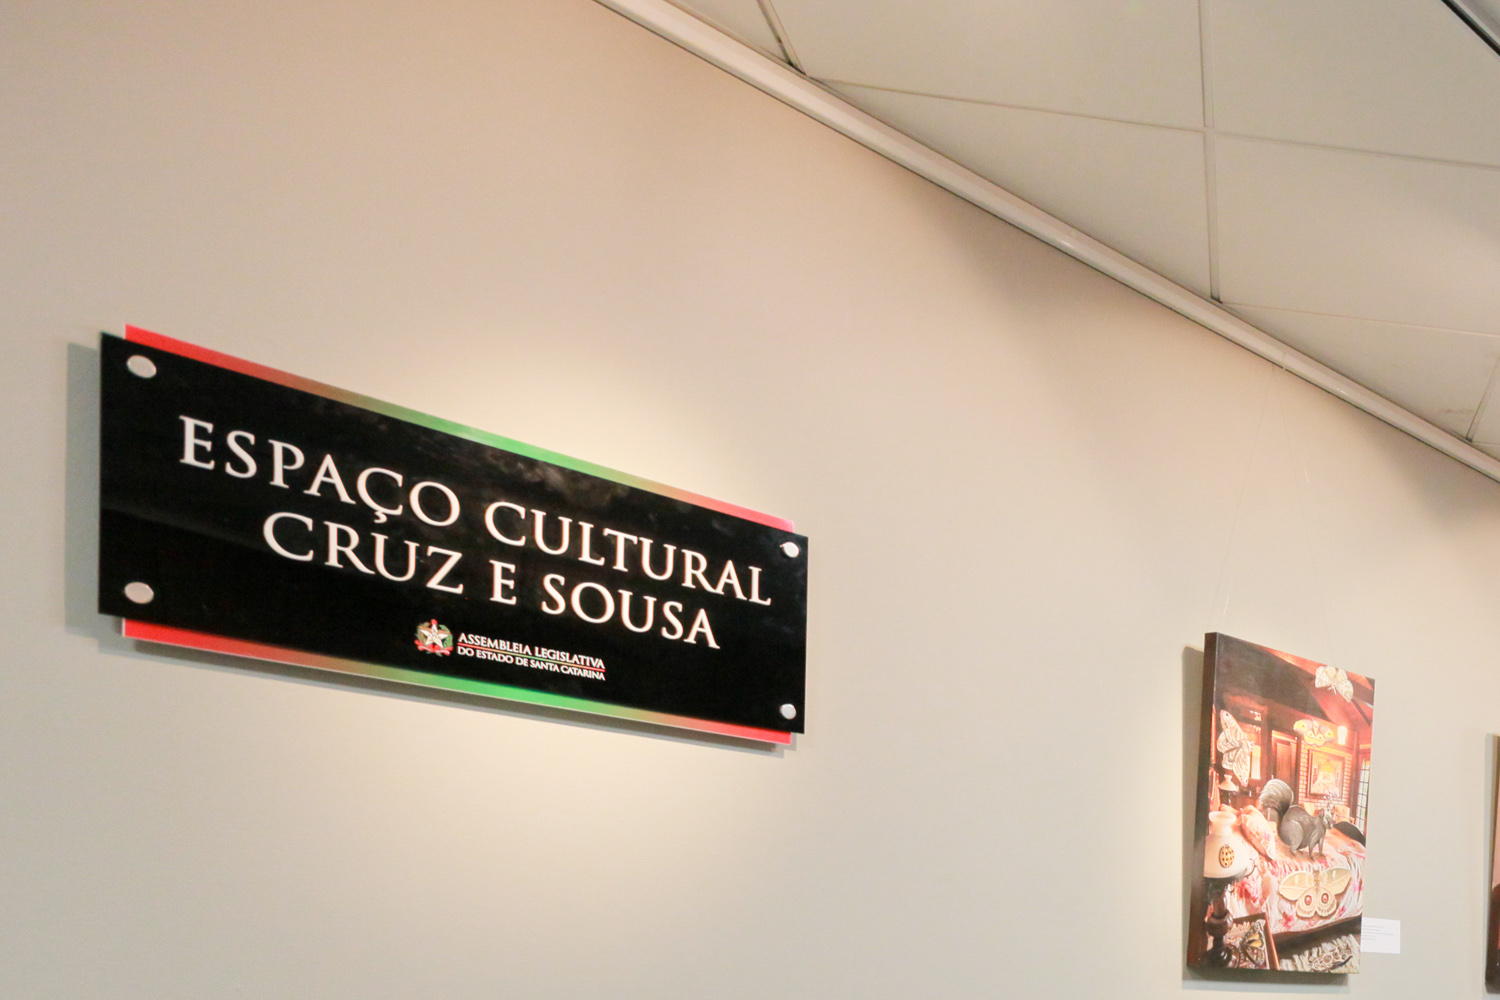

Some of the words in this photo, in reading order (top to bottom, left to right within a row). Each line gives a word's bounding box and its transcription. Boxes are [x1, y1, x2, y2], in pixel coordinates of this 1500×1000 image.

[179, 415, 461, 524] ESPAÇO
[485, 501, 772, 606] CULTURAL
[263, 511, 464, 594] CRUZ
[489, 559, 517, 606] E
[541, 573, 721, 649] SOUSA
[458, 634, 531, 655] ASSEMBLEIA
[535, 647, 605, 669] LEGISLATIVA
[458, 646, 474, 656] DO
[477, 651, 514, 664] ESTADO
[516, 657, 529, 667] DE
[531, 660, 560, 673] SANTA
[560, 665, 606, 680] CATARINA
